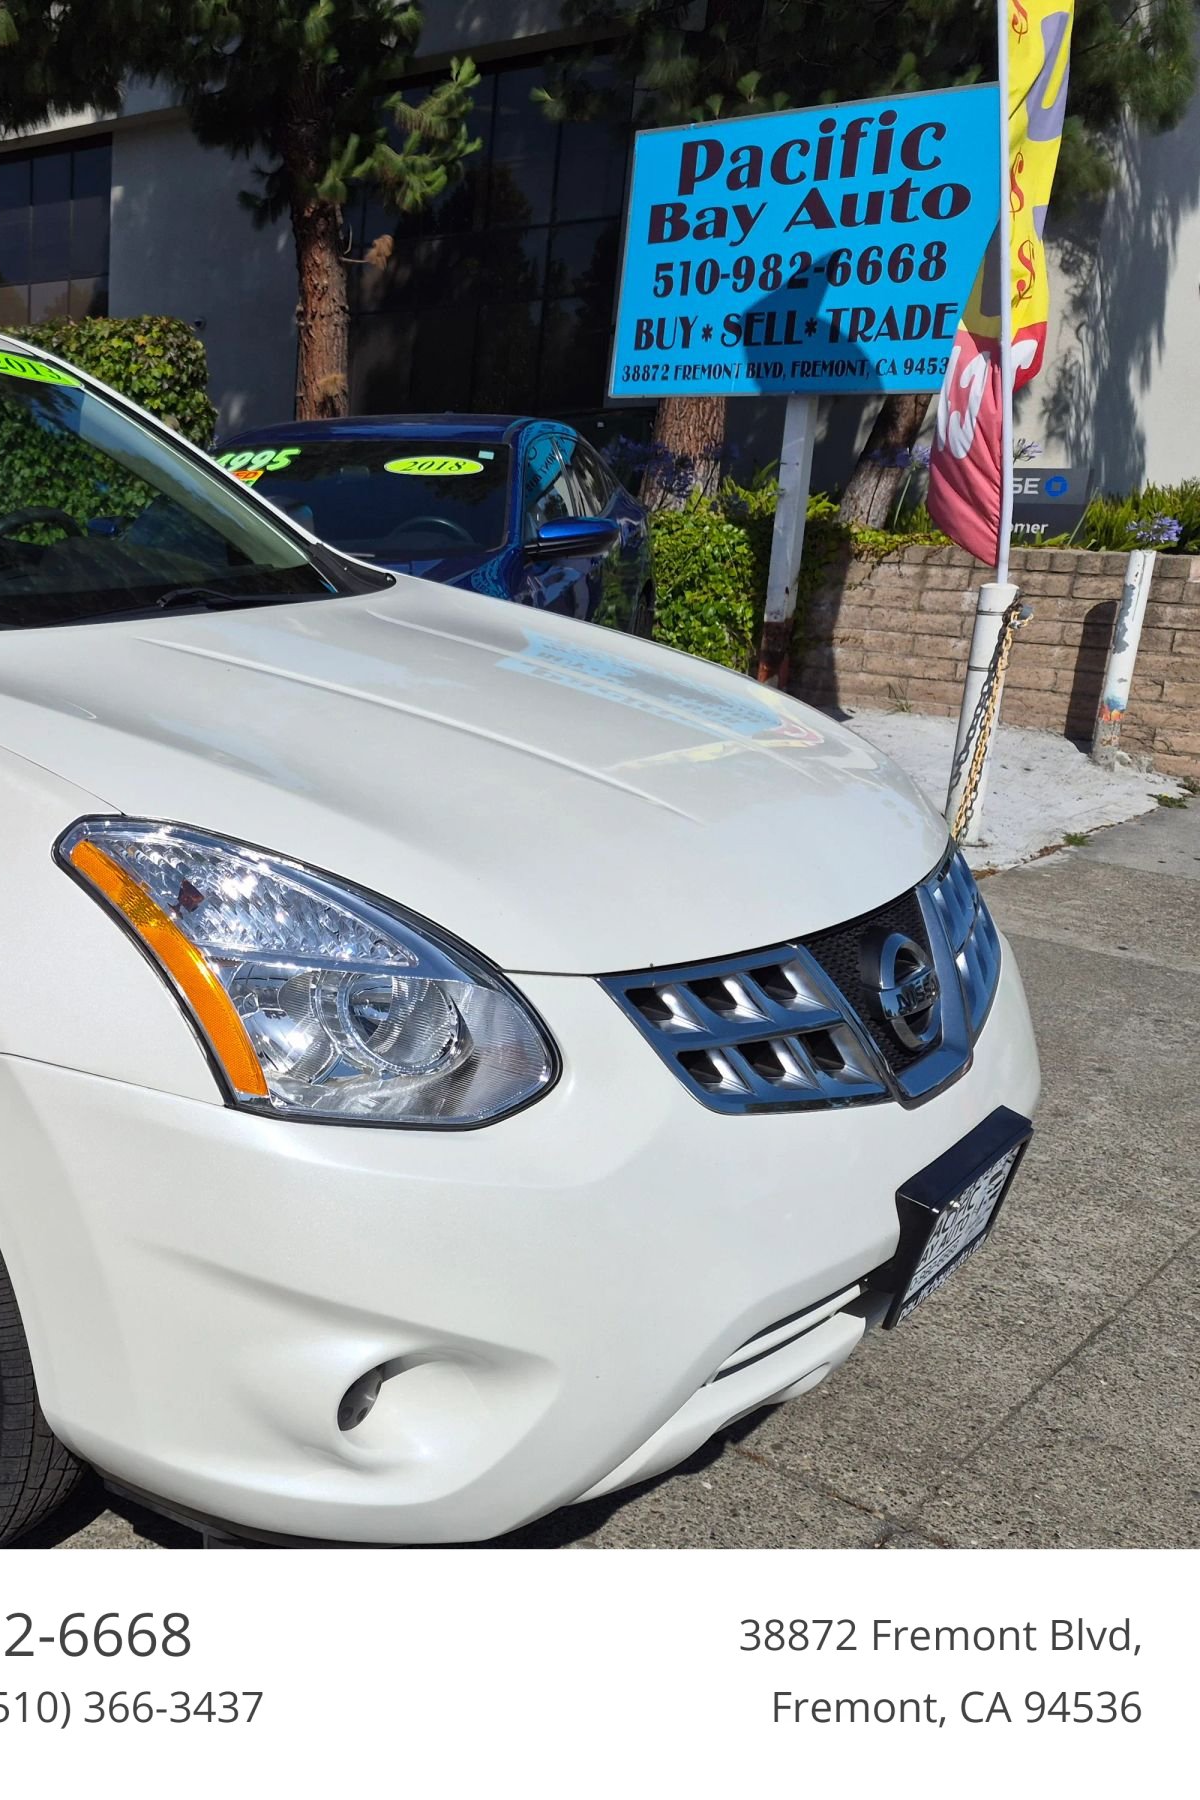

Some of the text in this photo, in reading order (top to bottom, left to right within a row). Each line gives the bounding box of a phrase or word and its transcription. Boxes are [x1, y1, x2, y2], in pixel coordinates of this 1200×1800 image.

[678, 110, 947, 197] Pacific
[647, 178, 971, 247] Bay Auto
[653, 241, 947, 298] 510-982-6668
[634, 302, 959, 351] BUY SELL TRADE
[622, 357, 950, 382] 38872 FREMONT BLVD, FREMONT, CA 9453
[400, 461, 466, 472] 2018
